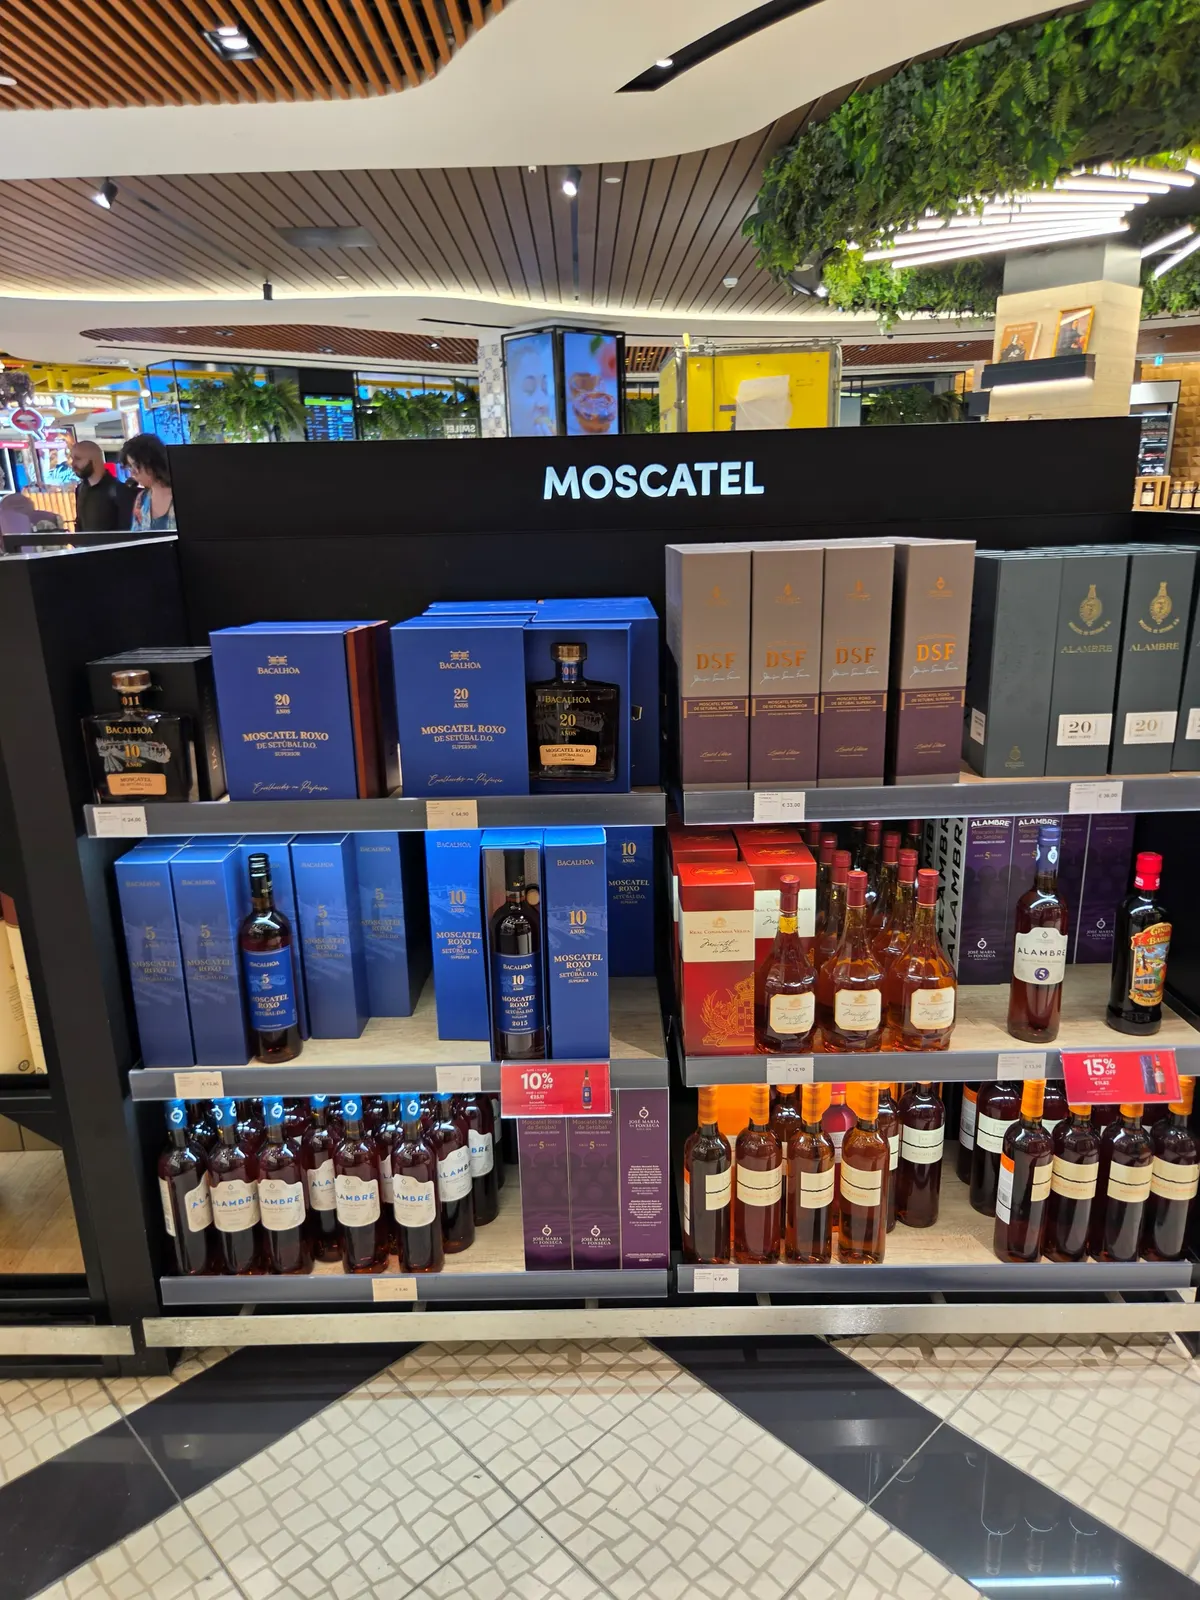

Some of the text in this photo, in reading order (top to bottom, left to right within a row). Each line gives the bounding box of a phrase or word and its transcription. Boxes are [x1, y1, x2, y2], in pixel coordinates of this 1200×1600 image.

[543, 461, 765, 500] MOSCATEL
[917, 642, 956, 662] DSF
[1060, 644, 1113, 654] ALAMBRE
[1129, 642, 1180, 652] ALAMBRE
[696, 651, 737, 670] DSF
[766, 648, 807, 668] DSF
[836, 646, 877, 665] DSF
[453, 688, 469, 700] 20
[274, 694, 290, 706] 20
[559, 713, 577, 727] 20
[1135, 719, 1158, 732] 20
[420, 724, 507, 735] MOSCATEL ROXO
[1068, 721, 1092, 734] 20
[242, 731, 329, 742] MOSCATEL ROXO
[433, 735, 445, 743] DE
[445, 733, 480, 742] SETÚBAL
[267, 740, 302, 749] SETÚBAL
[124, 744, 141, 758] 10
[971, 819, 1010, 828] ALAMBRE
[1018, 818, 1058, 827] ALAMBRE
[621, 842, 637, 856] 10
[984, 851, 991, 860] 5
[374, 887, 385, 901] 5
[448, 889, 467, 905] 10
[317, 904, 328, 919] 5
[568, 909, 587, 926] 10
[144, 926, 156, 941] 5
[200, 924, 211, 939] 5
[436, 931, 482, 939] MOSCATEL
[553, 953, 604, 962] MOSCATEL
[1017, 947, 1066, 957] ALAMBRE
[566, 961, 591, 969] ROXO
[262, 973, 270, 984] 5
[512, 974, 525, 985] 10
[559, 970, 586, 978] SETÚBAL
[1038, 969, 1046, 979] 5
[502, 994, 536, 1002] MOSCATEL
[257, 1001, 280, 1009] ROXO
[1082, 1058, 1116, 1076] 15%
[520, 1072, 554, 1090] 10%
[538, 1140, 545, 1150] 5
[589, 1140, 595, 1150] 5
